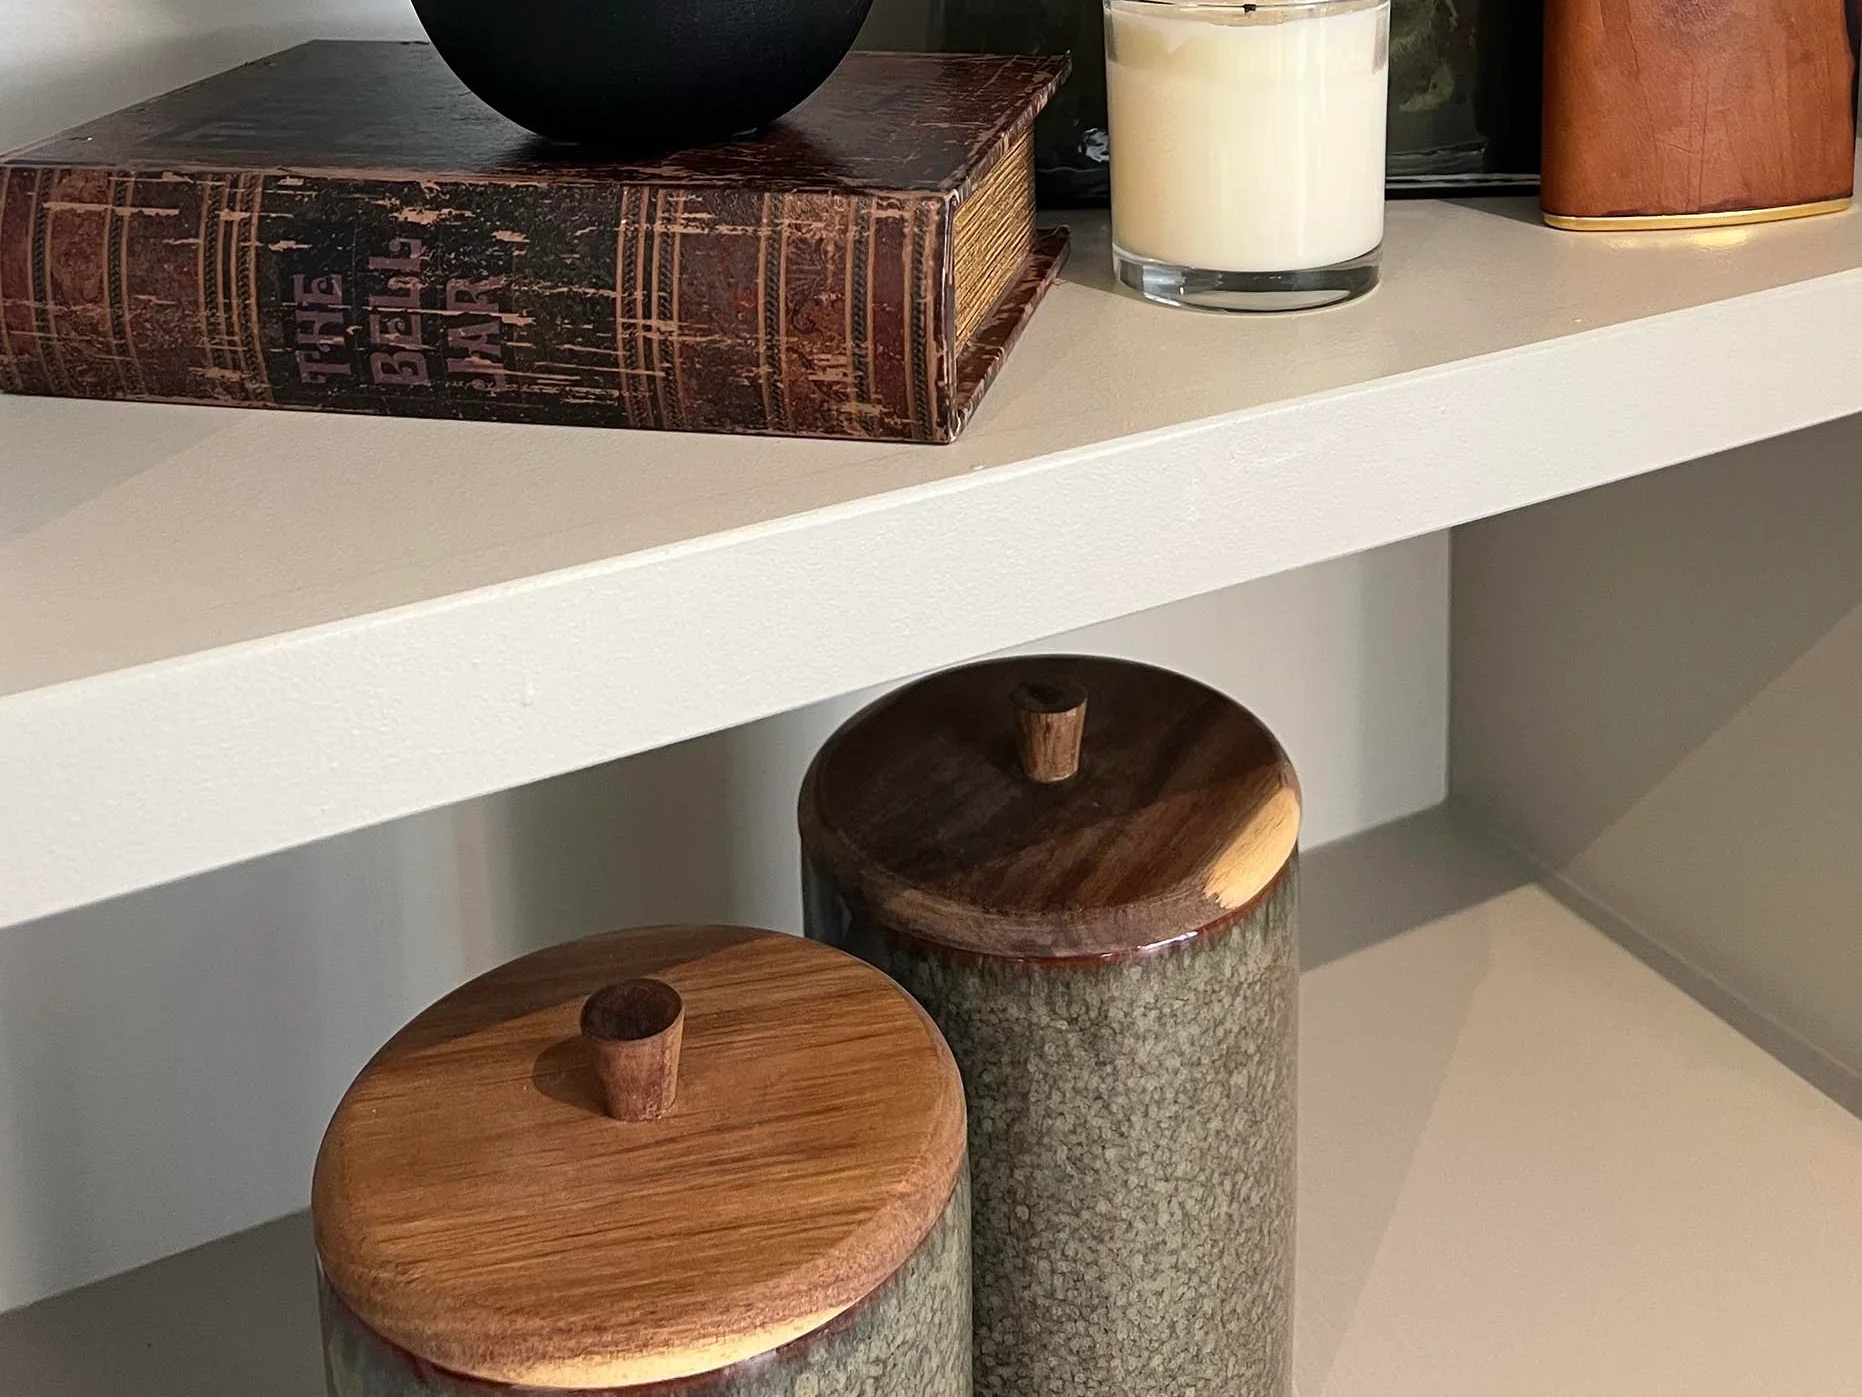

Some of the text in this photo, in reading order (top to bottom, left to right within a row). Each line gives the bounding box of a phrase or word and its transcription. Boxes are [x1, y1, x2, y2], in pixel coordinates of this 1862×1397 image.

[293, 274, 350, 384] THE
[368, 237, 431, 386] BELL
[446, 276, 506, 392] JAR
